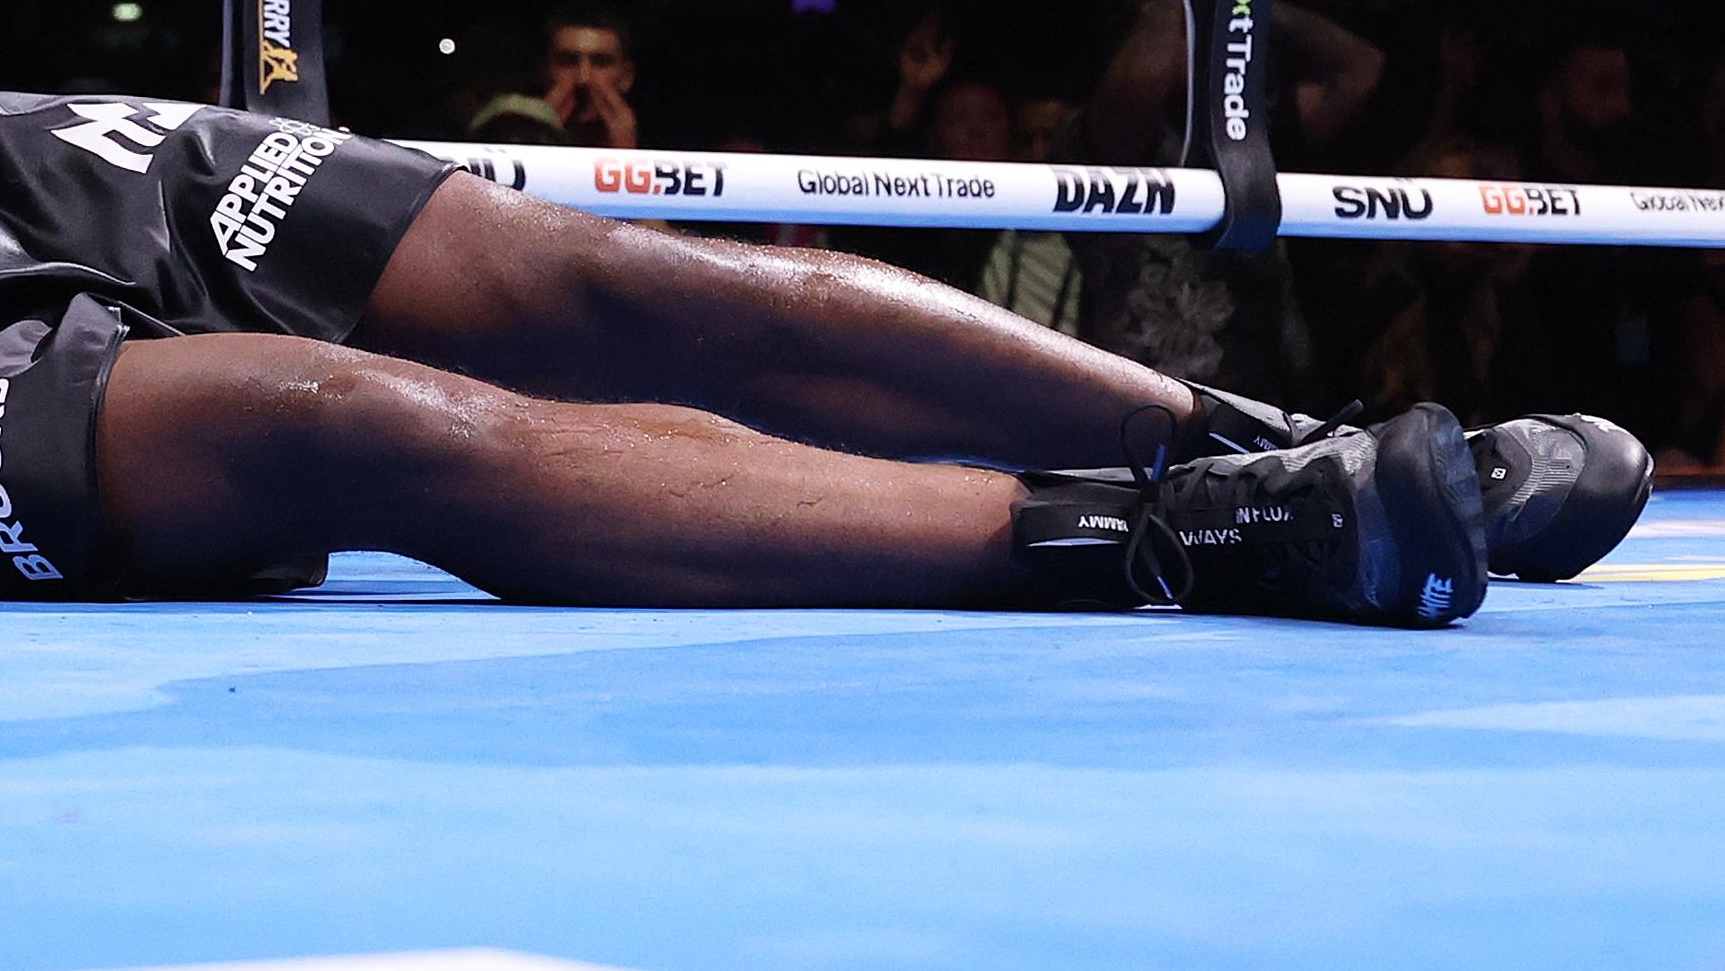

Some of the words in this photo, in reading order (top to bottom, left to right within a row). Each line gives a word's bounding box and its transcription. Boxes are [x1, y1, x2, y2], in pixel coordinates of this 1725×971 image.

[1223, 33, 1253, 141] Trade
[210, 131, 299, 256] APPLIED
[224, 128, 353, 272] NUTRITION
[797, 169, 870, 197] Global
[874, 171, 932, 198] Next
[936, 173, 995, 198] Trade
[1050, 164, 1175, 215] DAZN
